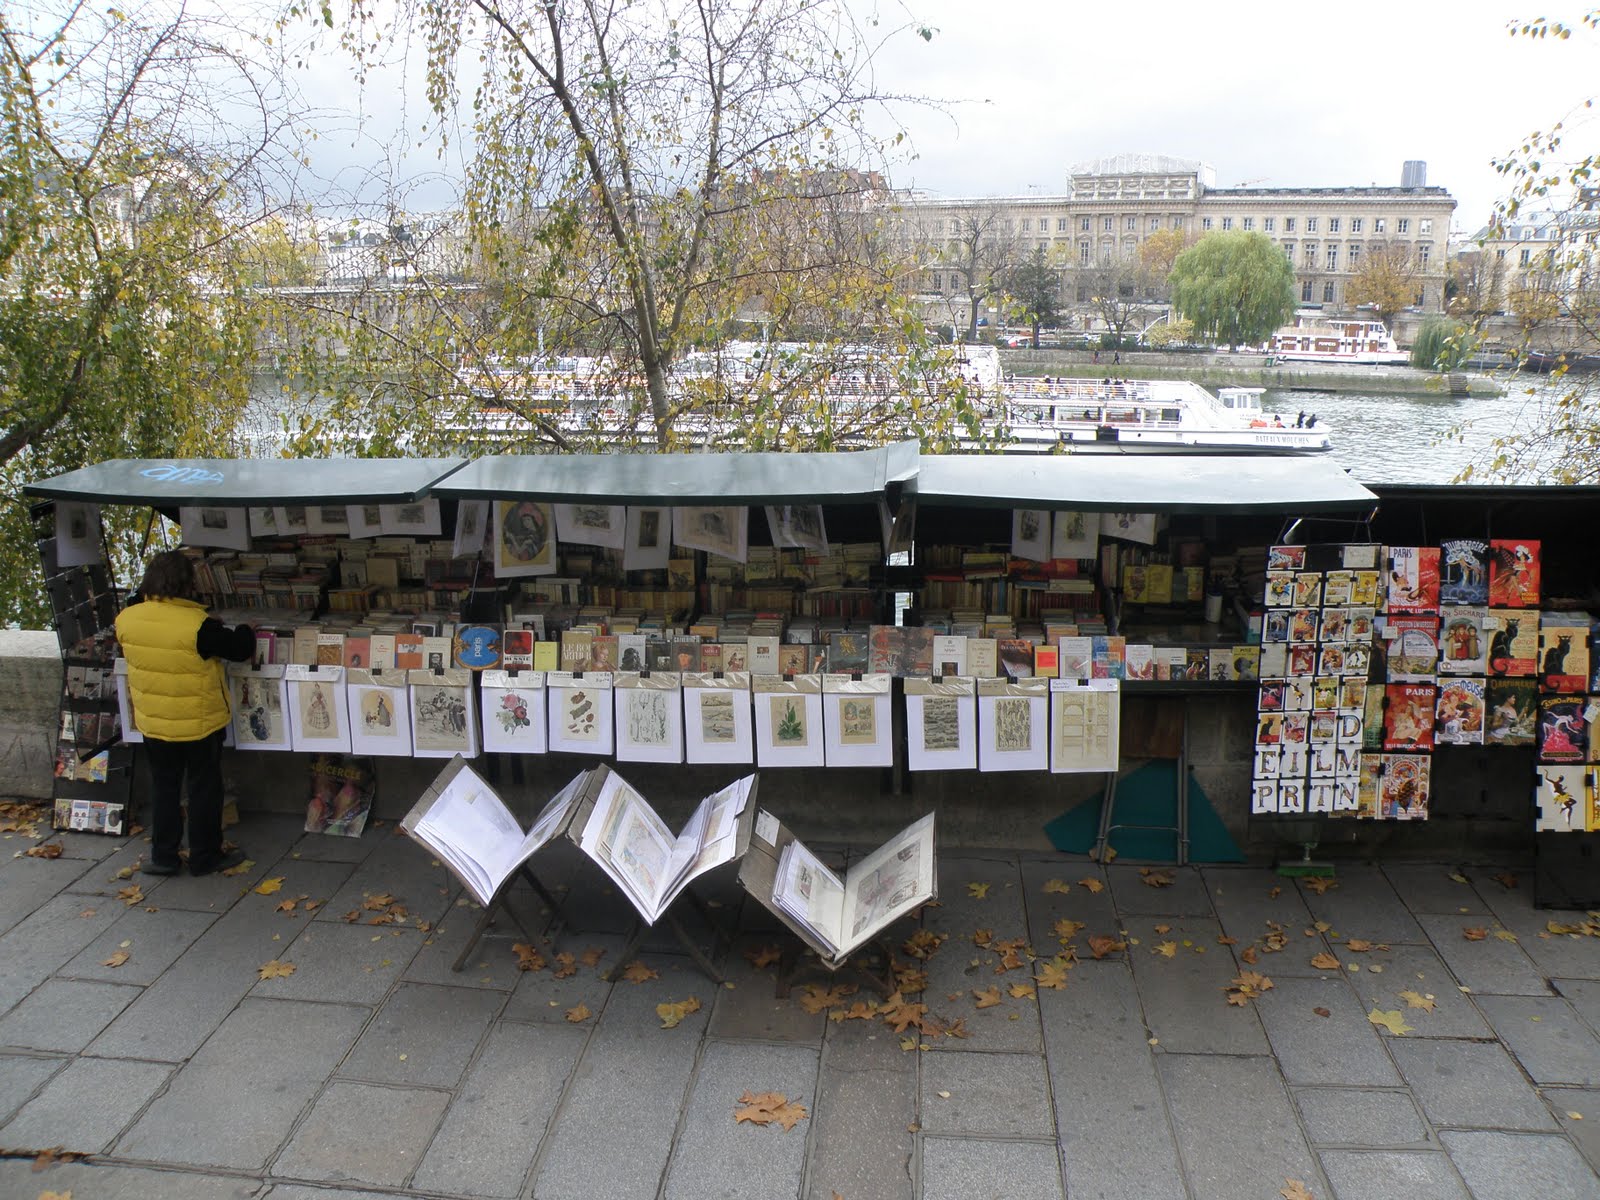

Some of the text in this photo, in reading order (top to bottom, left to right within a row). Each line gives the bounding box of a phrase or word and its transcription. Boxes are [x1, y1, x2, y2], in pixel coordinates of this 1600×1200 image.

[1255, 435, 1310, 444] BATEAUX MOUCHES
[1393, 548, 1412, 558] PARIS
[1453, 607, 1486, 619] SUCHARD
[474, 636, 482, 657] paris
[562, 643, 592, 652] LE ROI
[562, 651, 592, 661] ARTHUR
[1405, 688, 1434, 696] PARIS
[1460, 679, 1485, 700] MEUSE
